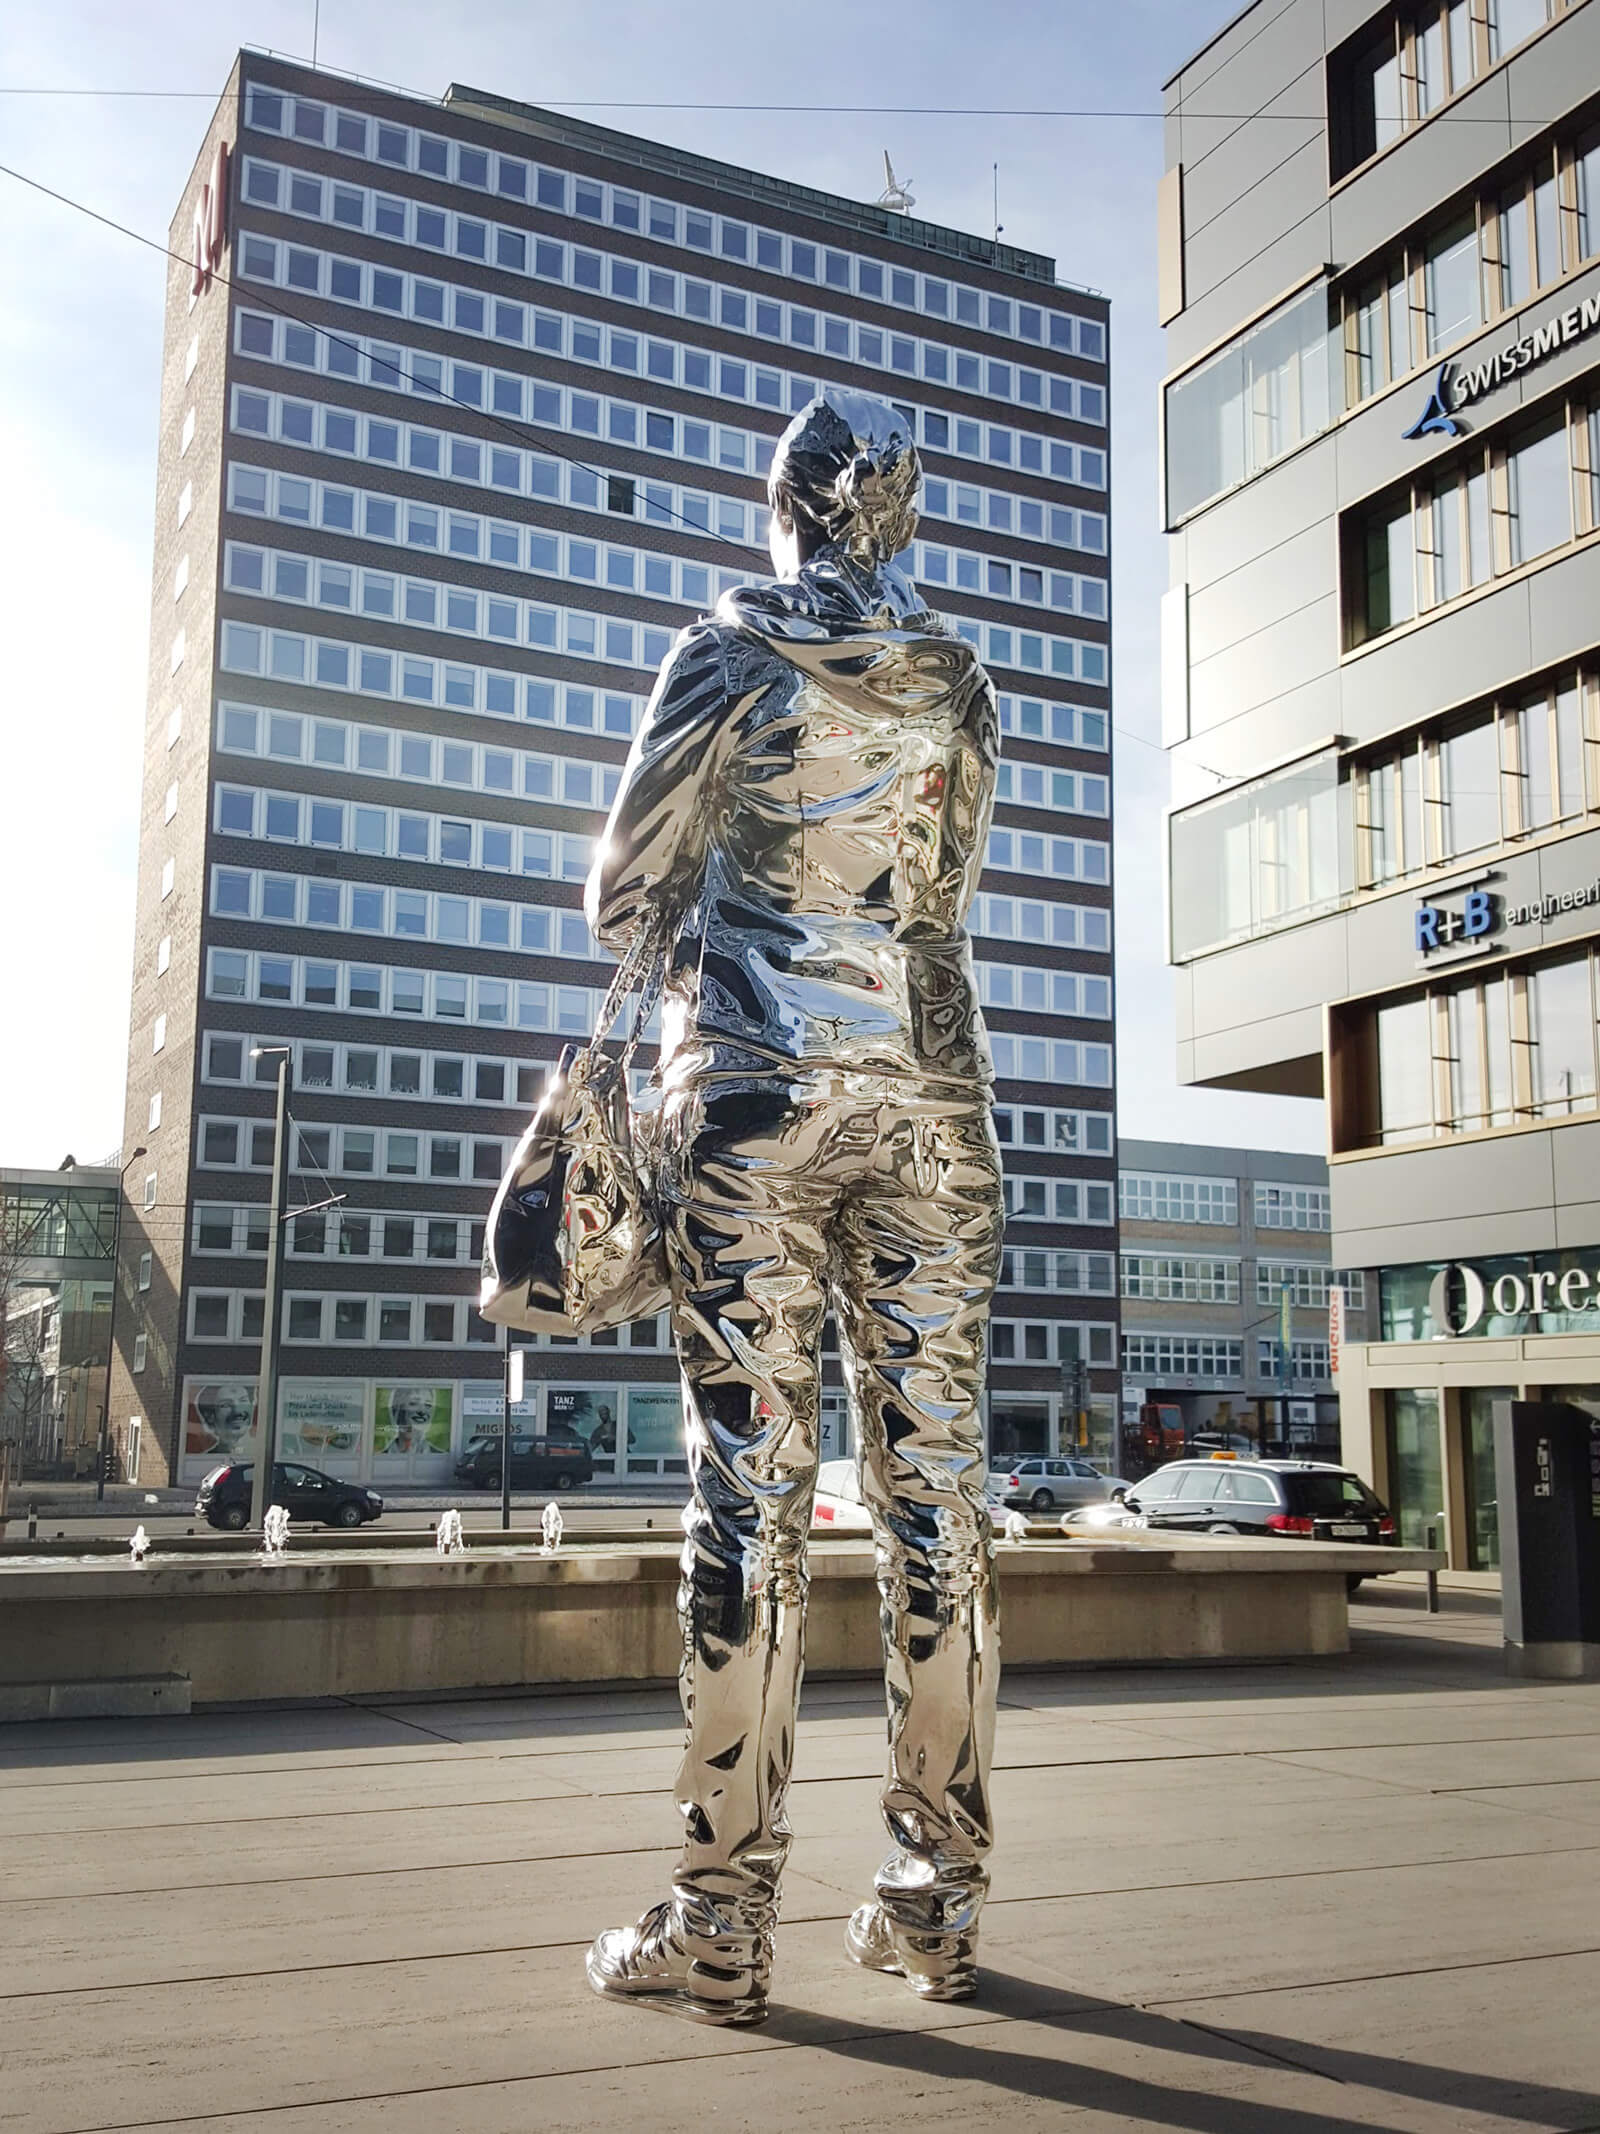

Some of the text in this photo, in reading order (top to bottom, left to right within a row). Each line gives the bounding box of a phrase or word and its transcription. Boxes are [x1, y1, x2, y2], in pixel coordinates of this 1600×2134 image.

[1415, 891, 1491, 951] R+B
[554, 1396, 575, 1405] TANZ
[475, 1424, 523, 1434] MIGOS
